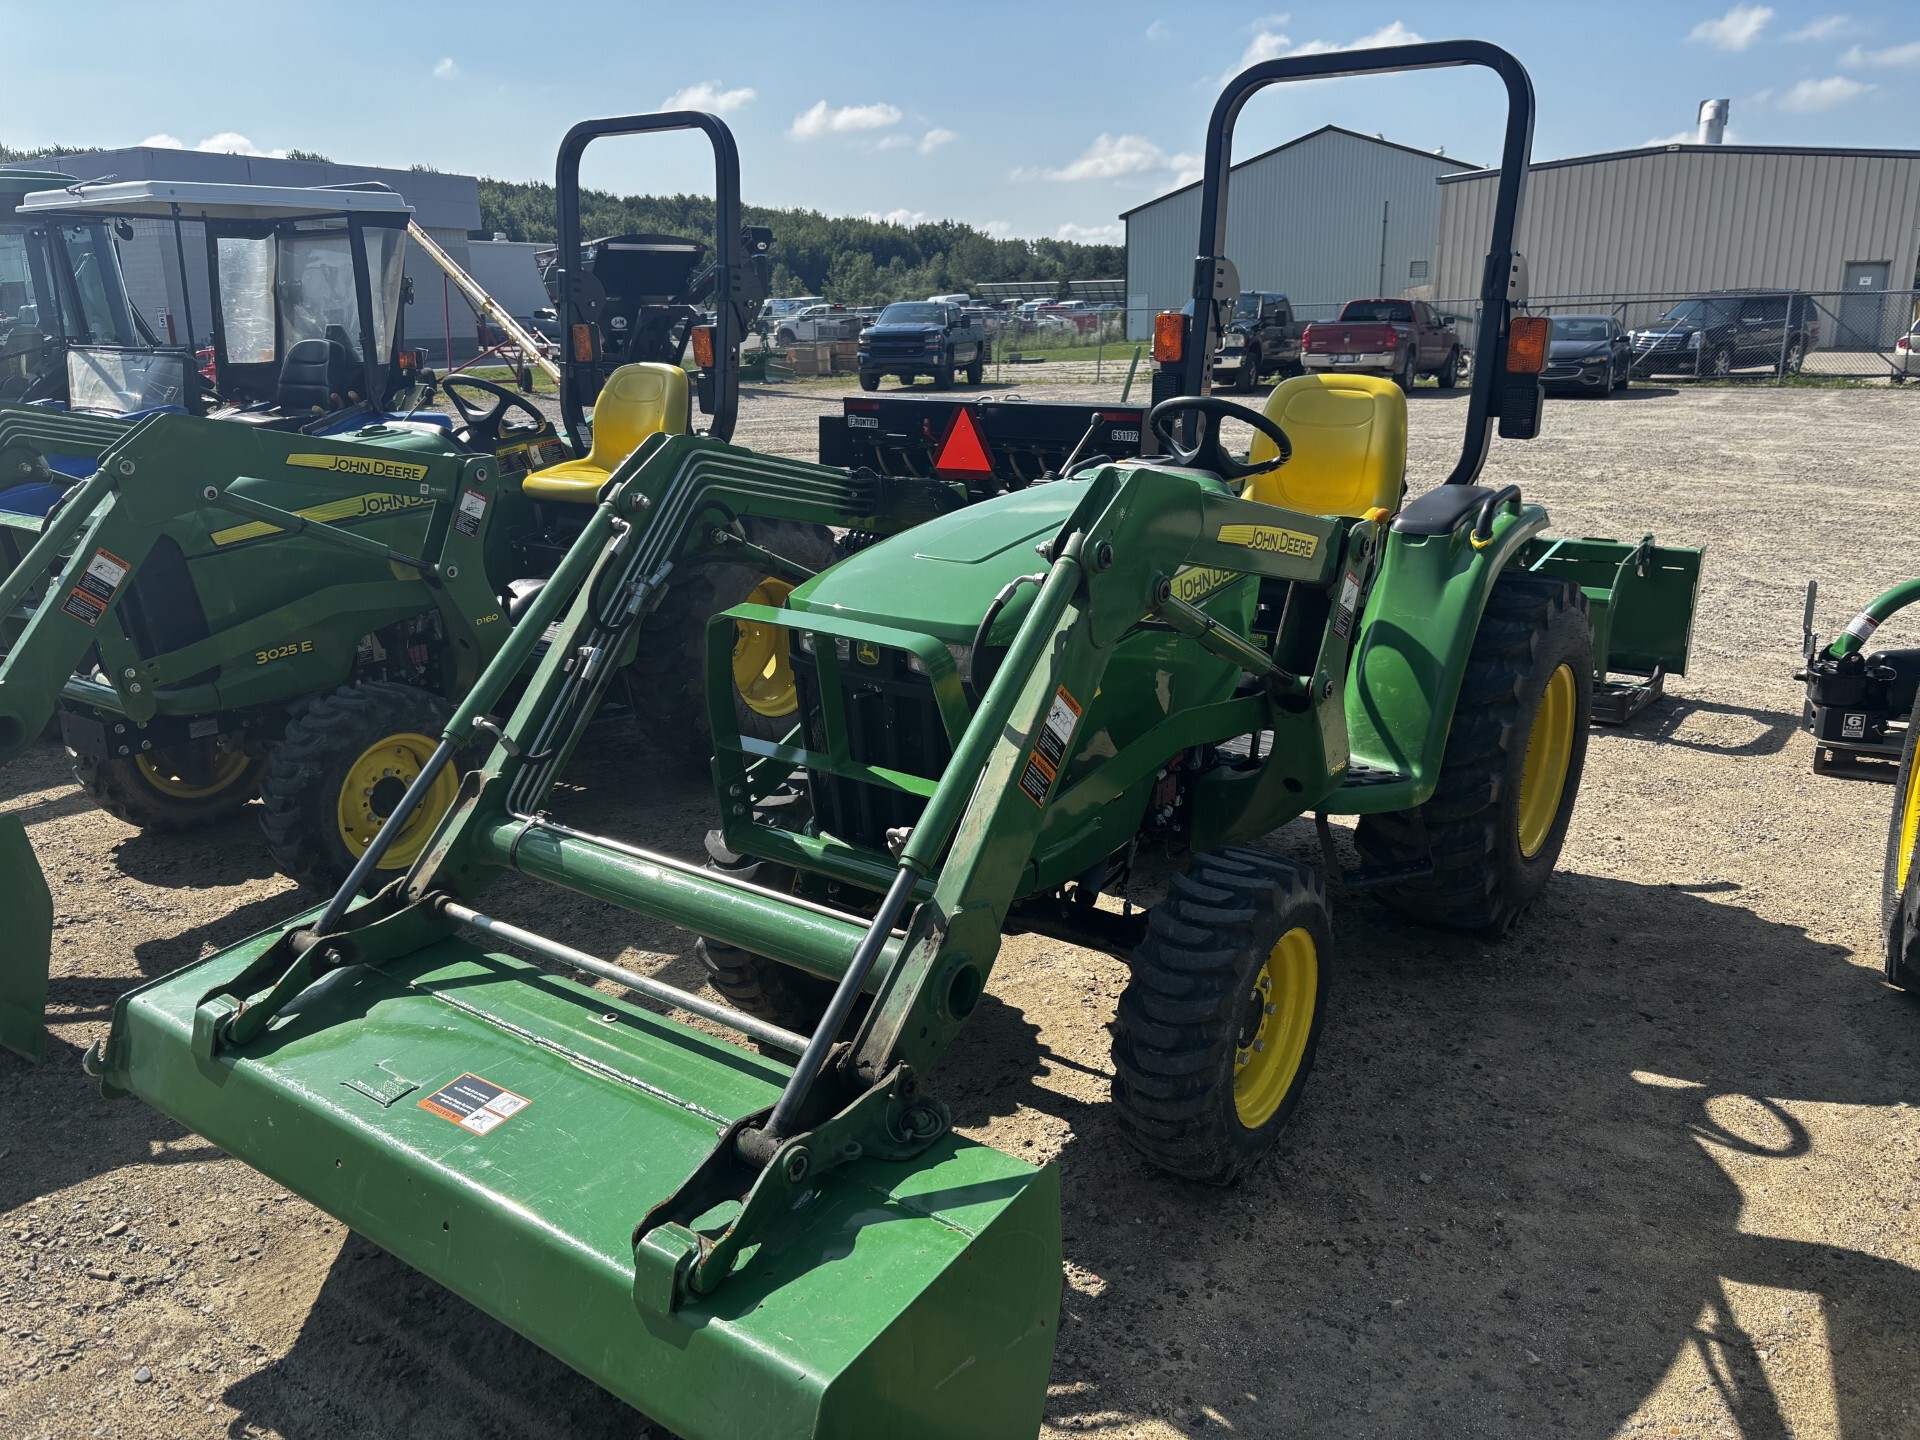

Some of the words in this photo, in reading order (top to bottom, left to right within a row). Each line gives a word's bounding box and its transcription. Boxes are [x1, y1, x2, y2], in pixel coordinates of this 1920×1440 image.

[160, 318, 166, 327] 5
[1111, 430, 1139, 442] GS1172
[328, 456, 371, 473] JOHN
[373, 461, 421, 480] DEERE
[357, 494, 406, 515] JOHN
[1247, 527, 1279, 550] JOHN
[1280, 531, 1313, 556] DEERE
[1180, 569, 1211, 600] JOHN
[476, 613, 499, 626] D160
[255, 643, 298, 665] 3025
[301, 640, 313, 653] E
[1847, 716, 1862, 727] 6
